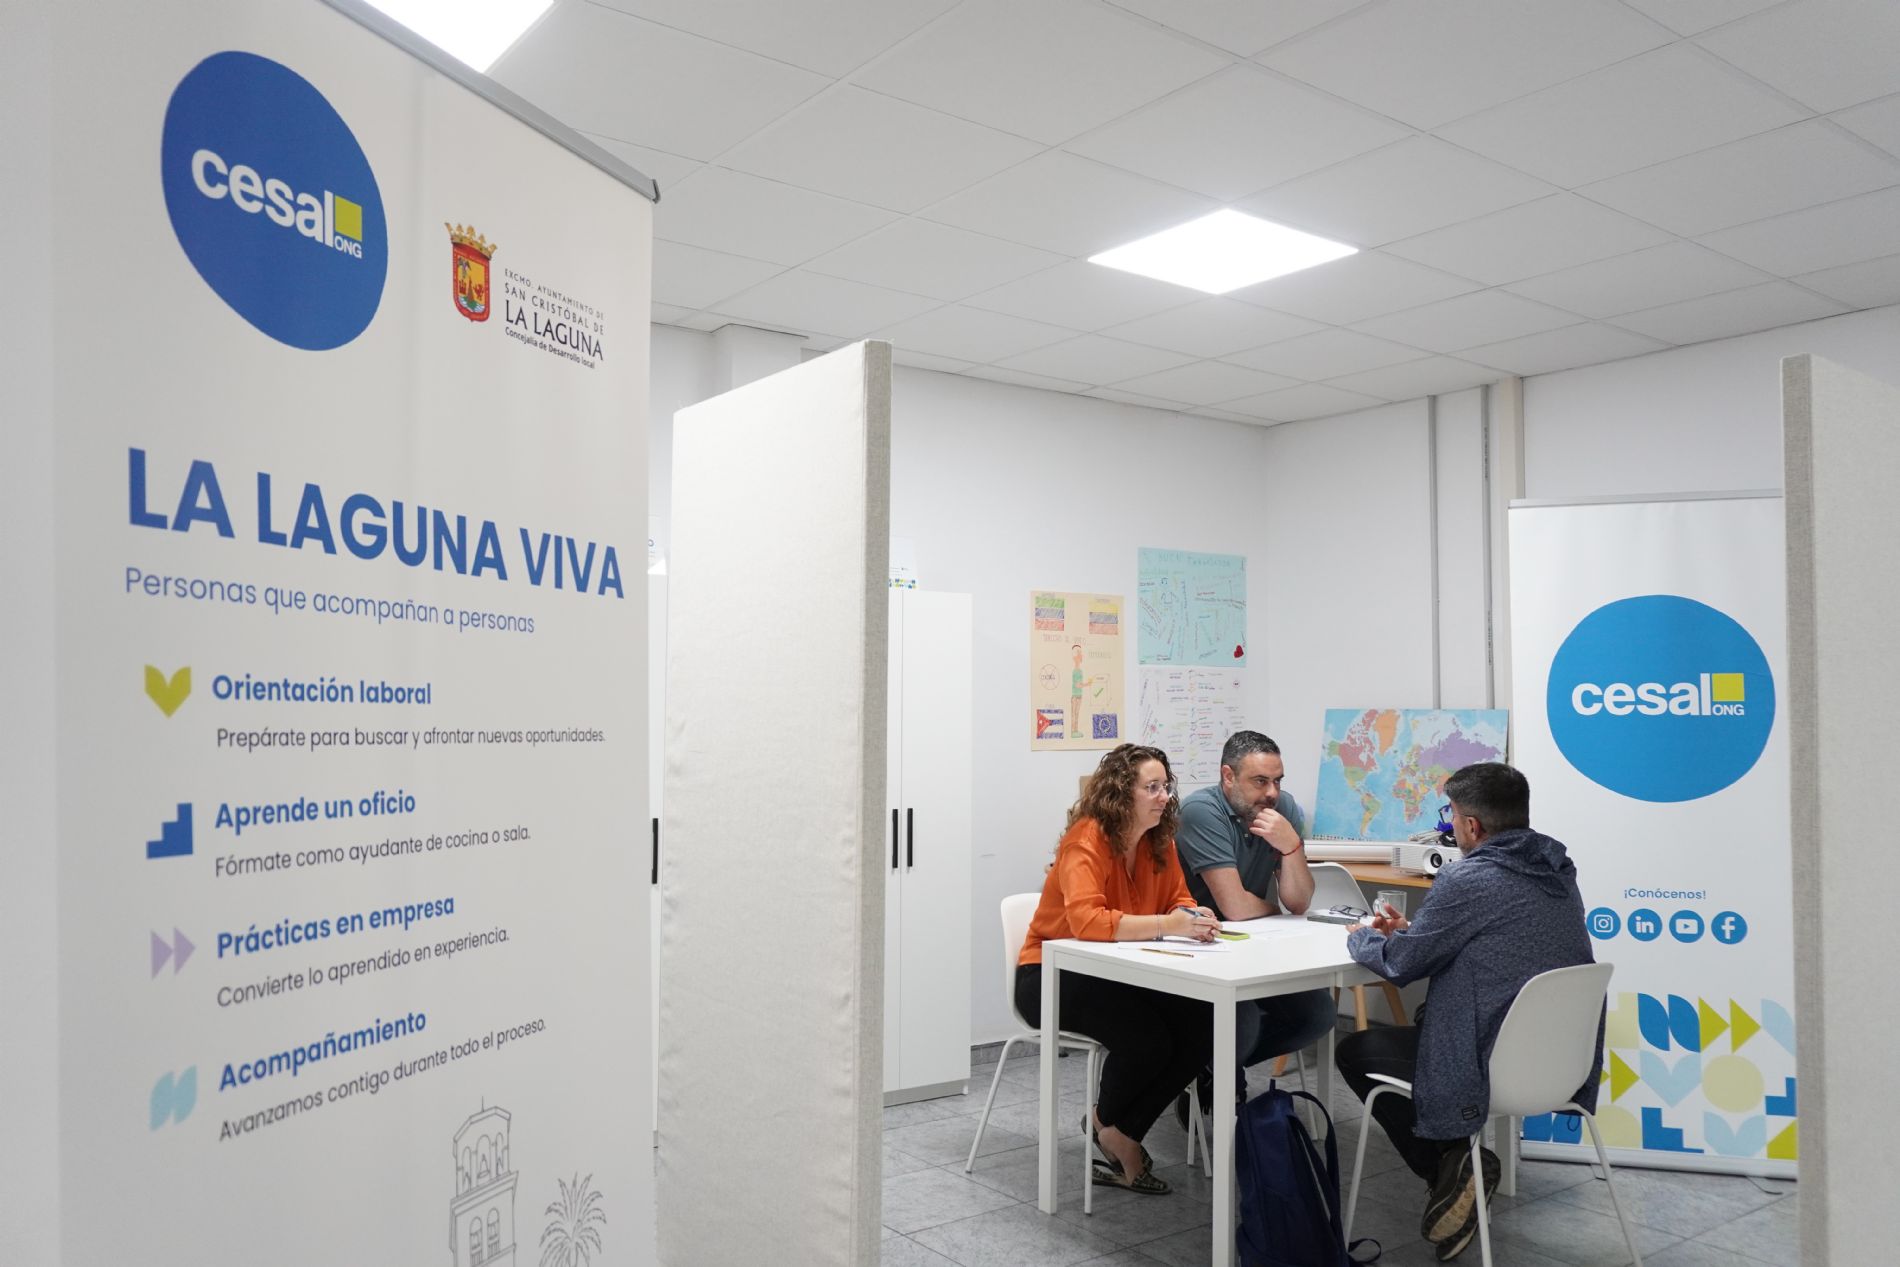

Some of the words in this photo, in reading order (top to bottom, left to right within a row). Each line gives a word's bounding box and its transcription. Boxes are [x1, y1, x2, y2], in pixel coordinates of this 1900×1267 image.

[192, 149, 334, 248] cesal
[334, 235, 363, 259] ONG
[504, 267, 534, 288] EXCMO.
[537, 284, 594, 316] AYUNTAMIENTO
[595, 310, 604, 321] DE
[504, 282, 526, 301] SAN
[532, 295, 589, 329] CRISTÓBAL
[593, 322, 604, 336] DE
[505, 299, 528, 331] LA
[533, 311, 604, 361] LAGUNA
[538, 340, 547, 351] de
[548, 343, 581, 364] Desarrollo
[128, 447, 236, 539] LA
[257, 471, 508, 581] LAGUNA
[519, 527, 625, 599] VIVA
[126, 566, 257, 605] Personas
[264, 586, 307, 615] que
[313, 592, 439, 625] acompañan
[443, 608, 454, 625] a
[459, 609, 535, 633] personas
[212, 673, 354, 703] Orientación
[360, 680, 432, 704] laboral
[1572, 673, 1711, 716] cesal
[1712, 703, 1745, 716] ONG
[217, 726, 306, 753] Prepárate
[310, 731, 350, 752] para
[355, 727, 408, 746] buscar
[412, 733, 420, 750] y
[424, 726, 474, 744] afrontar
[478, 728, 523, 744] nuevas
[526, 726, 606, 748] oportunidades.
[215, 797, 319, 836] Aprende
[324, 799, 353, 819] un
[359, 790, 416, 816] oficio
[215, 852, 292, 878] Fórmate
[296, 847, 345, 867] como
[349, 837, 423, 865] ayudante
[426, 834, 443, 852] de
[446, 829, 489, 849] cocina
[492, 830, 500, 843] o
[503, 825, 531, 842] sala.
[1624, 888, 1706, 900] ¡Conócenos!
[217, 918, 331, 959] Prácticas
[336, 913, 364, 935] en
[369, 897, 455, 931] empresa
[217, 972, 304, 1007] Convierte
[308, 967, 324, 987] lo
[328, 948, 411, 985] aprendido
[414, 945, 431, 962] en
[434, 926, 510, 960] experiencia.
[219, 1012, 426, 1092] Acompañamiento
[219, 1091, 324, 1142] Avanzamos
[327, 1070, 389, 1103] contigo
[393, 1049, 448, 1081] durante
[450, 1038, 479, 1060] todo
[482, 1031, 494, 1050] el
[497, 1018, 547, 1050] proceso.
